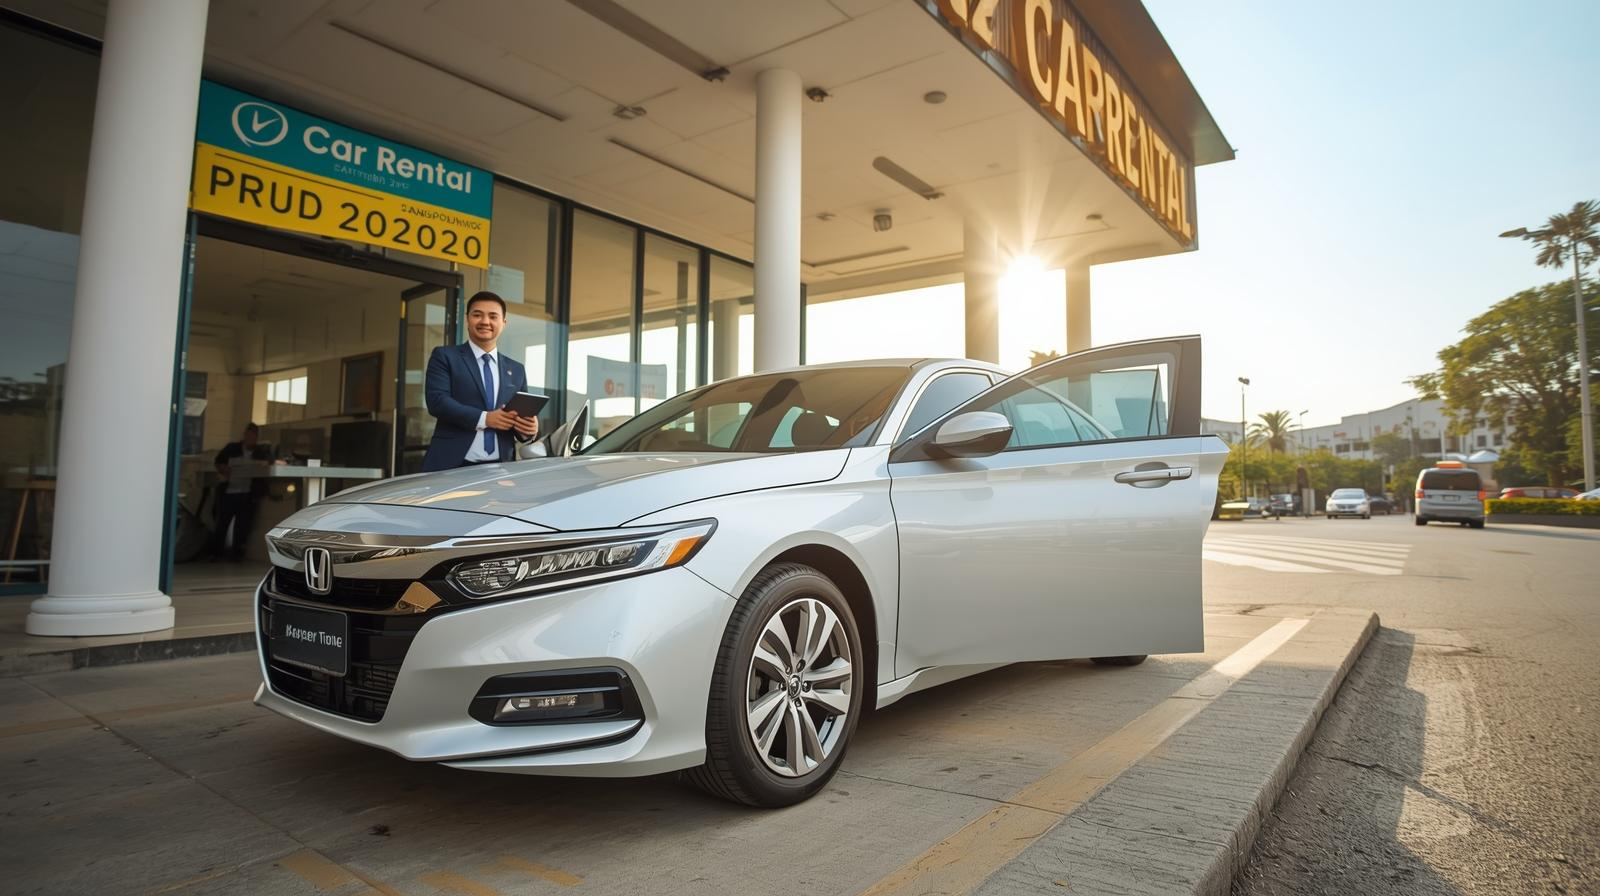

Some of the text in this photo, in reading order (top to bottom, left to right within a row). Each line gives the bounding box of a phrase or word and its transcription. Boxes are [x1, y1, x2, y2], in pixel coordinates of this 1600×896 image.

[303, 125, 367, 165] Car
[376, 145, 472, 193] Rental
[209, 164, 322, 220] PRUD
[338, 202, 482, 260] 202020
